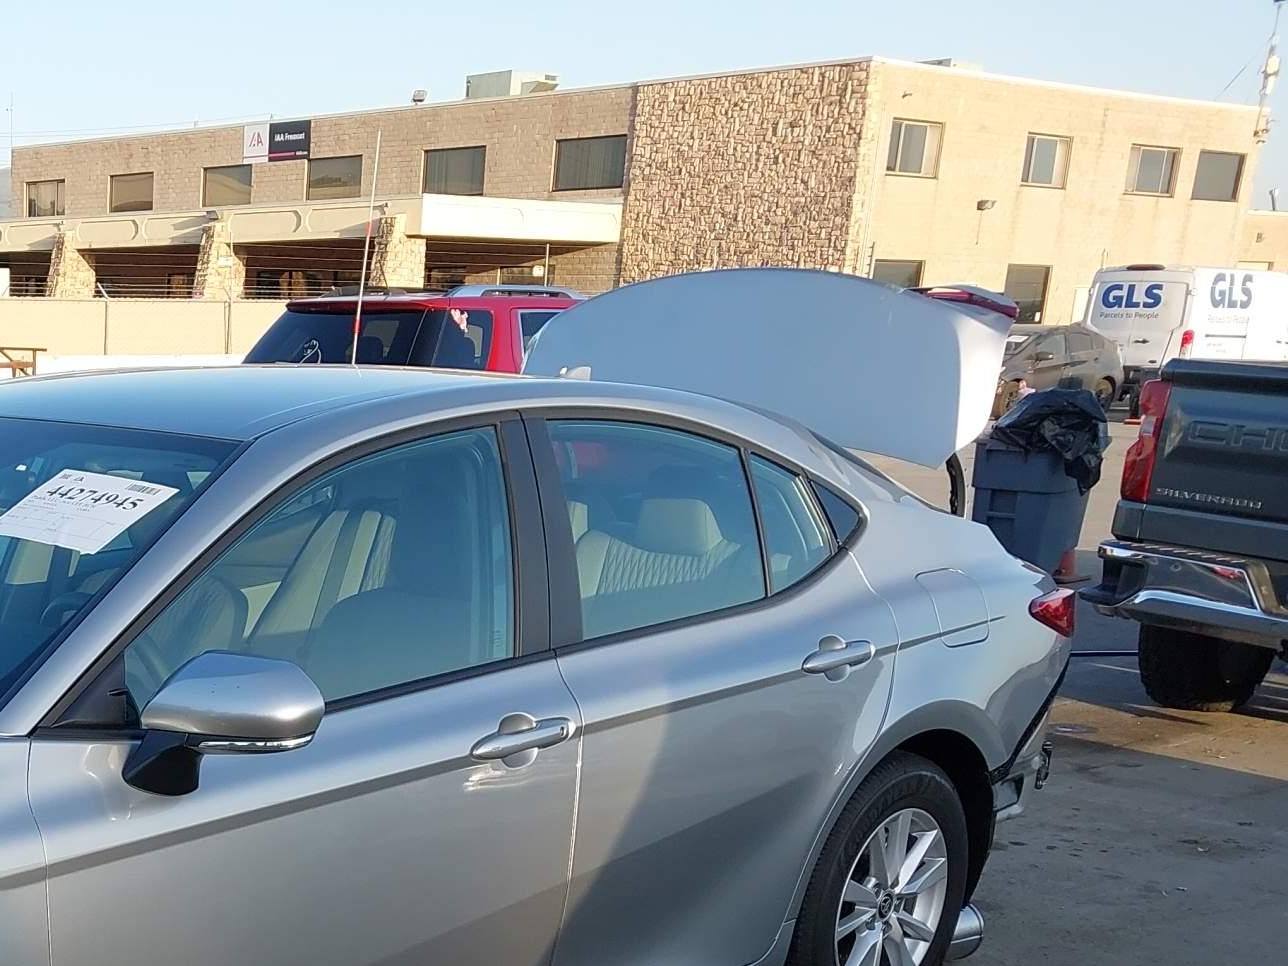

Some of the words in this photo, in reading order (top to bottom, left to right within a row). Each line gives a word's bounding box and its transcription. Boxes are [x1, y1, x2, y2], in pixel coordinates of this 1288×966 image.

[1102, 284, 1163, 309] GLS
[1210, 273, 1253, 309] GLS
[1100, 311, 1123, 319] Parcels
[1134, 312, 1159, 320] People
[46, 485, 144, 511] 44274945
[1155, 487, 1263, 509] SILVERADO
